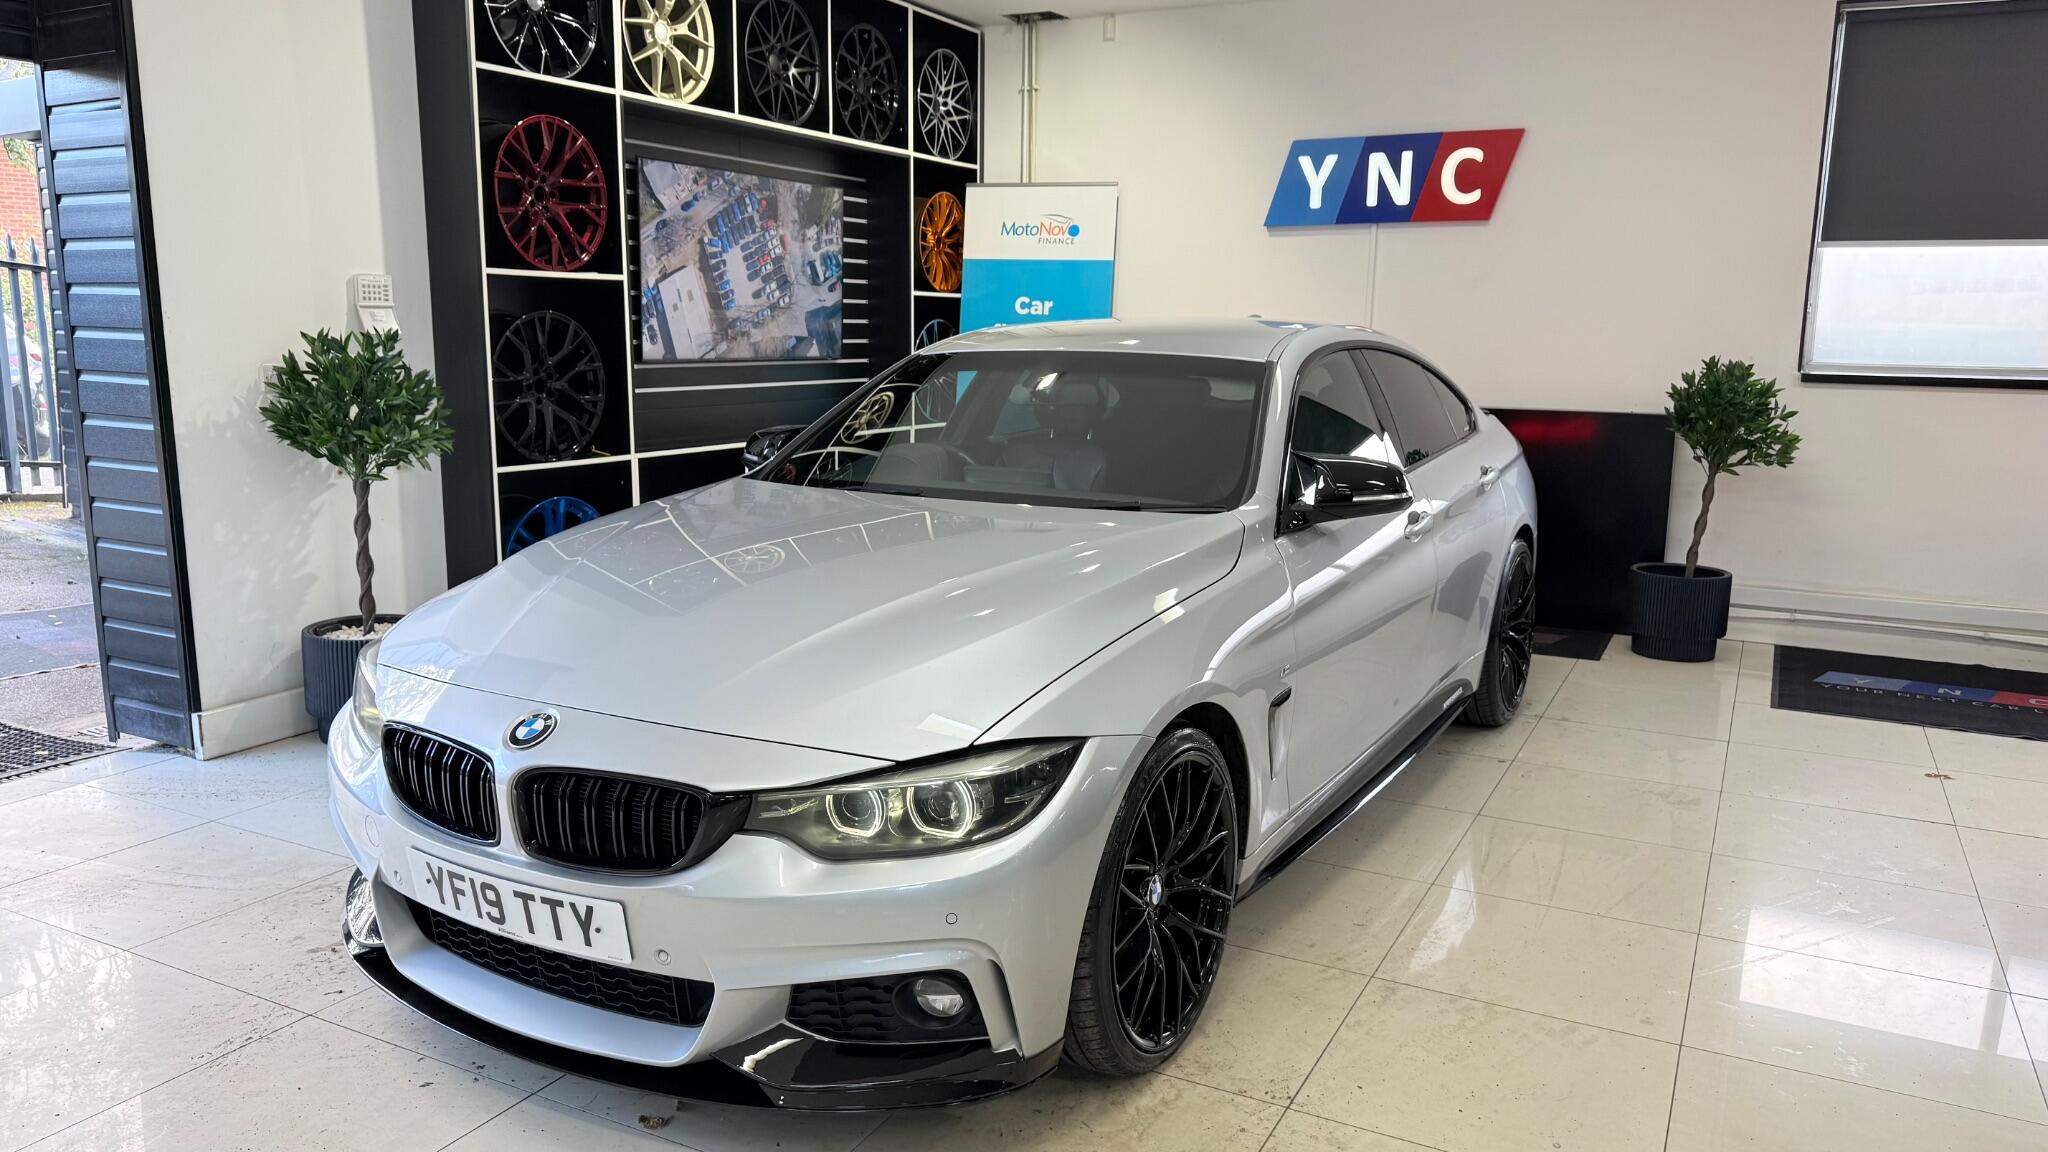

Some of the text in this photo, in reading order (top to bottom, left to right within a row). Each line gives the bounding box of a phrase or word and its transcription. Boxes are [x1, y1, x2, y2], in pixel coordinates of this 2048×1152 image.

[1297, 146, 1484, 209] YNC
[1001, 220, 1080, 238] MotoNovo
[1038, 237, 1075, 245] FINANCE
[1014, 296, 1053, 316] Car
[1820, 683, 1883, 695] YOUR
[1897, 691, 1959, 703] NEXT
[425, 861, 594, 948] YF19 TTY
